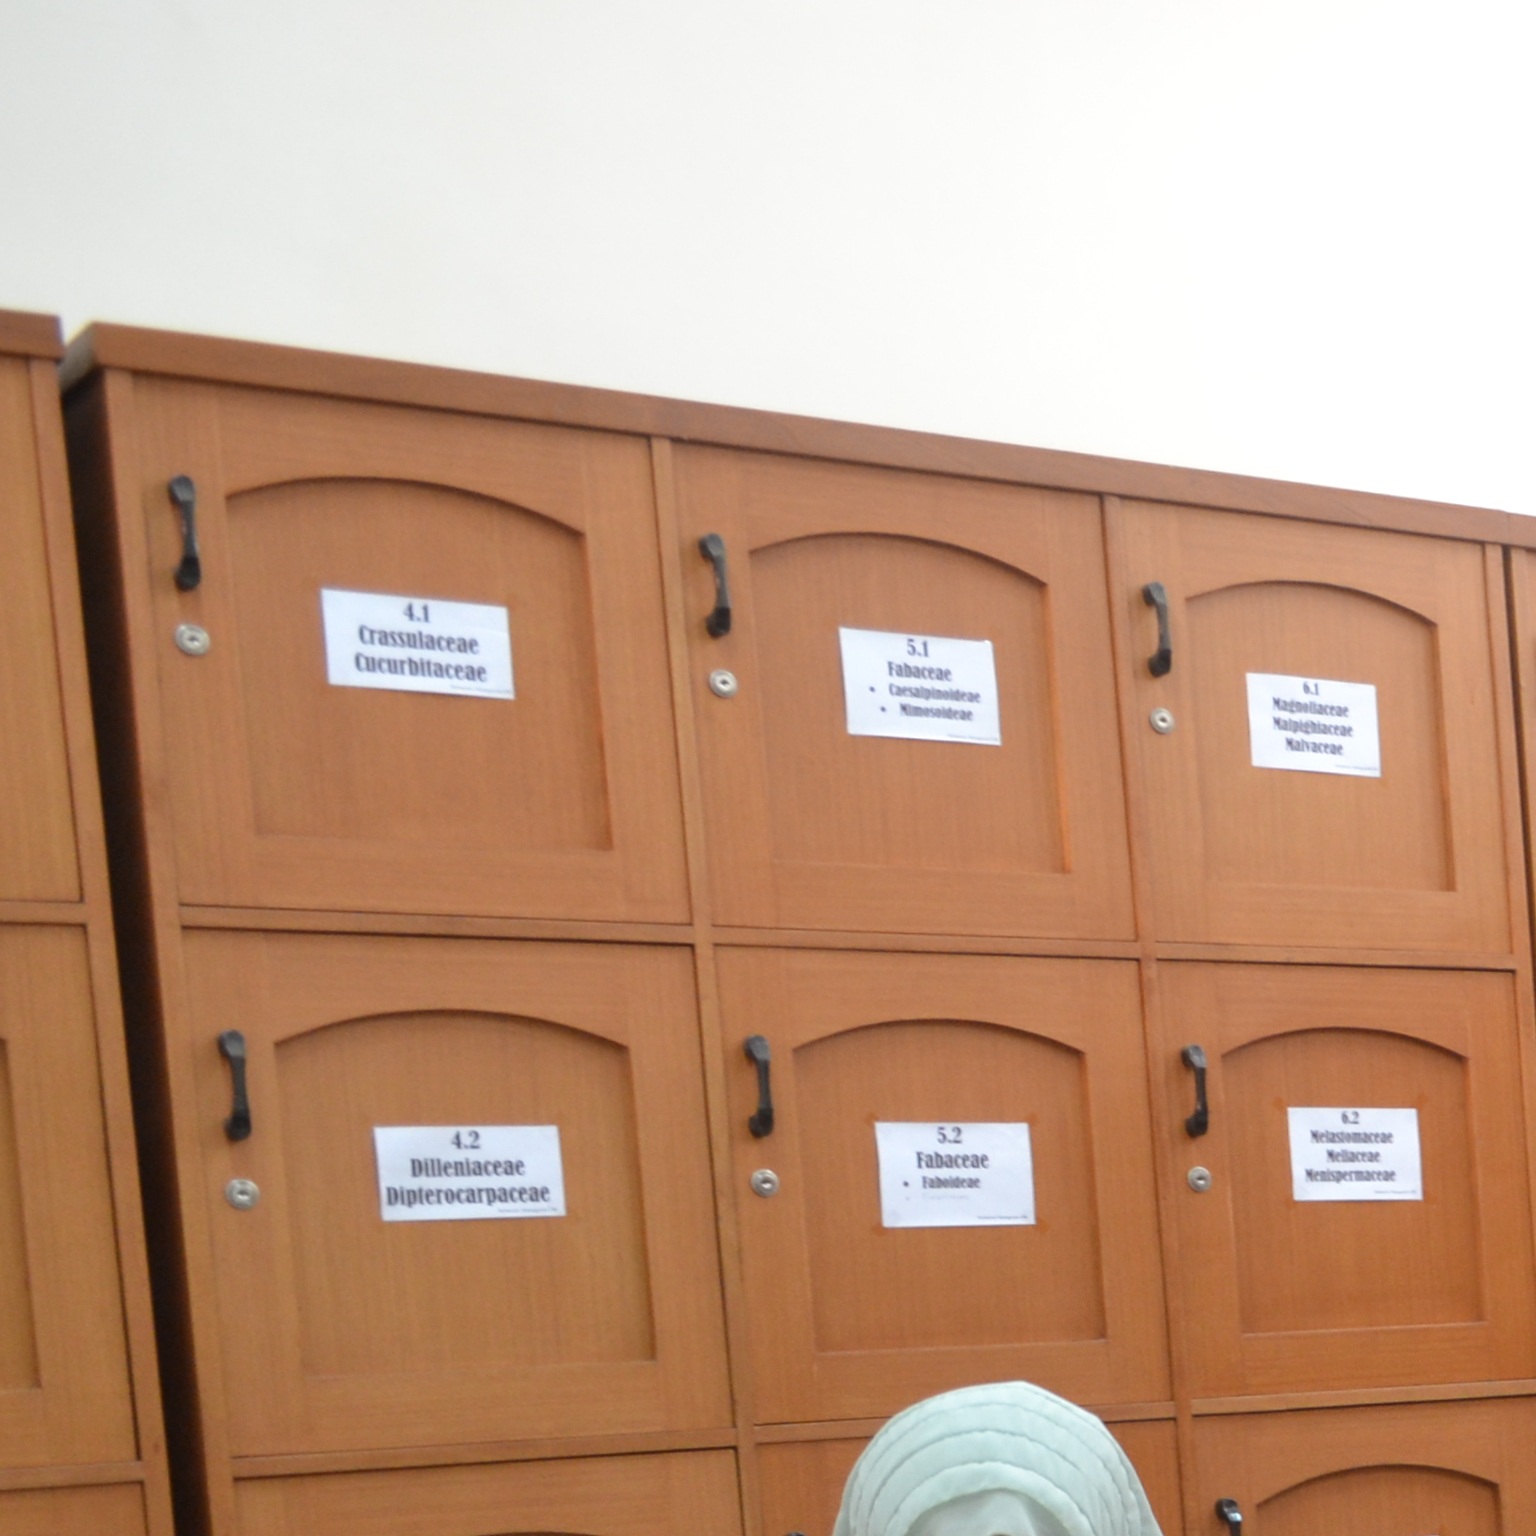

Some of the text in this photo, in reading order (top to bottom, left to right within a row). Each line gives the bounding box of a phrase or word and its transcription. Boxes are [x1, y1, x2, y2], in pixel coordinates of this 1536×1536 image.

[403, 603, 430, 624] 4.1
[359, 626, 480, 654] Crassulaceae
[907, 639, 929, 658] 5.1
[354, 653, 487, 683] Cucurbitaceae
[887, 661, 952, 681] Fabaceae
[1303, 681, 1319, 695] 6.1
[1272, 697, 1349, 717] Magnoliaceae
[1285, 738, 1343, 755] Malvaceae
[1341, 1111, 1359, 1125] 6.2
[451, 1131, 481, 1150] 4.2
[937, 1127, 962, 1144] 5.2
[410, 1158, 526, 1178] Dilleniaceae
[915, 1151, 989, 1169] Fabaceae
[386, 1184, 550, 1208] Dipterocarpaceae
